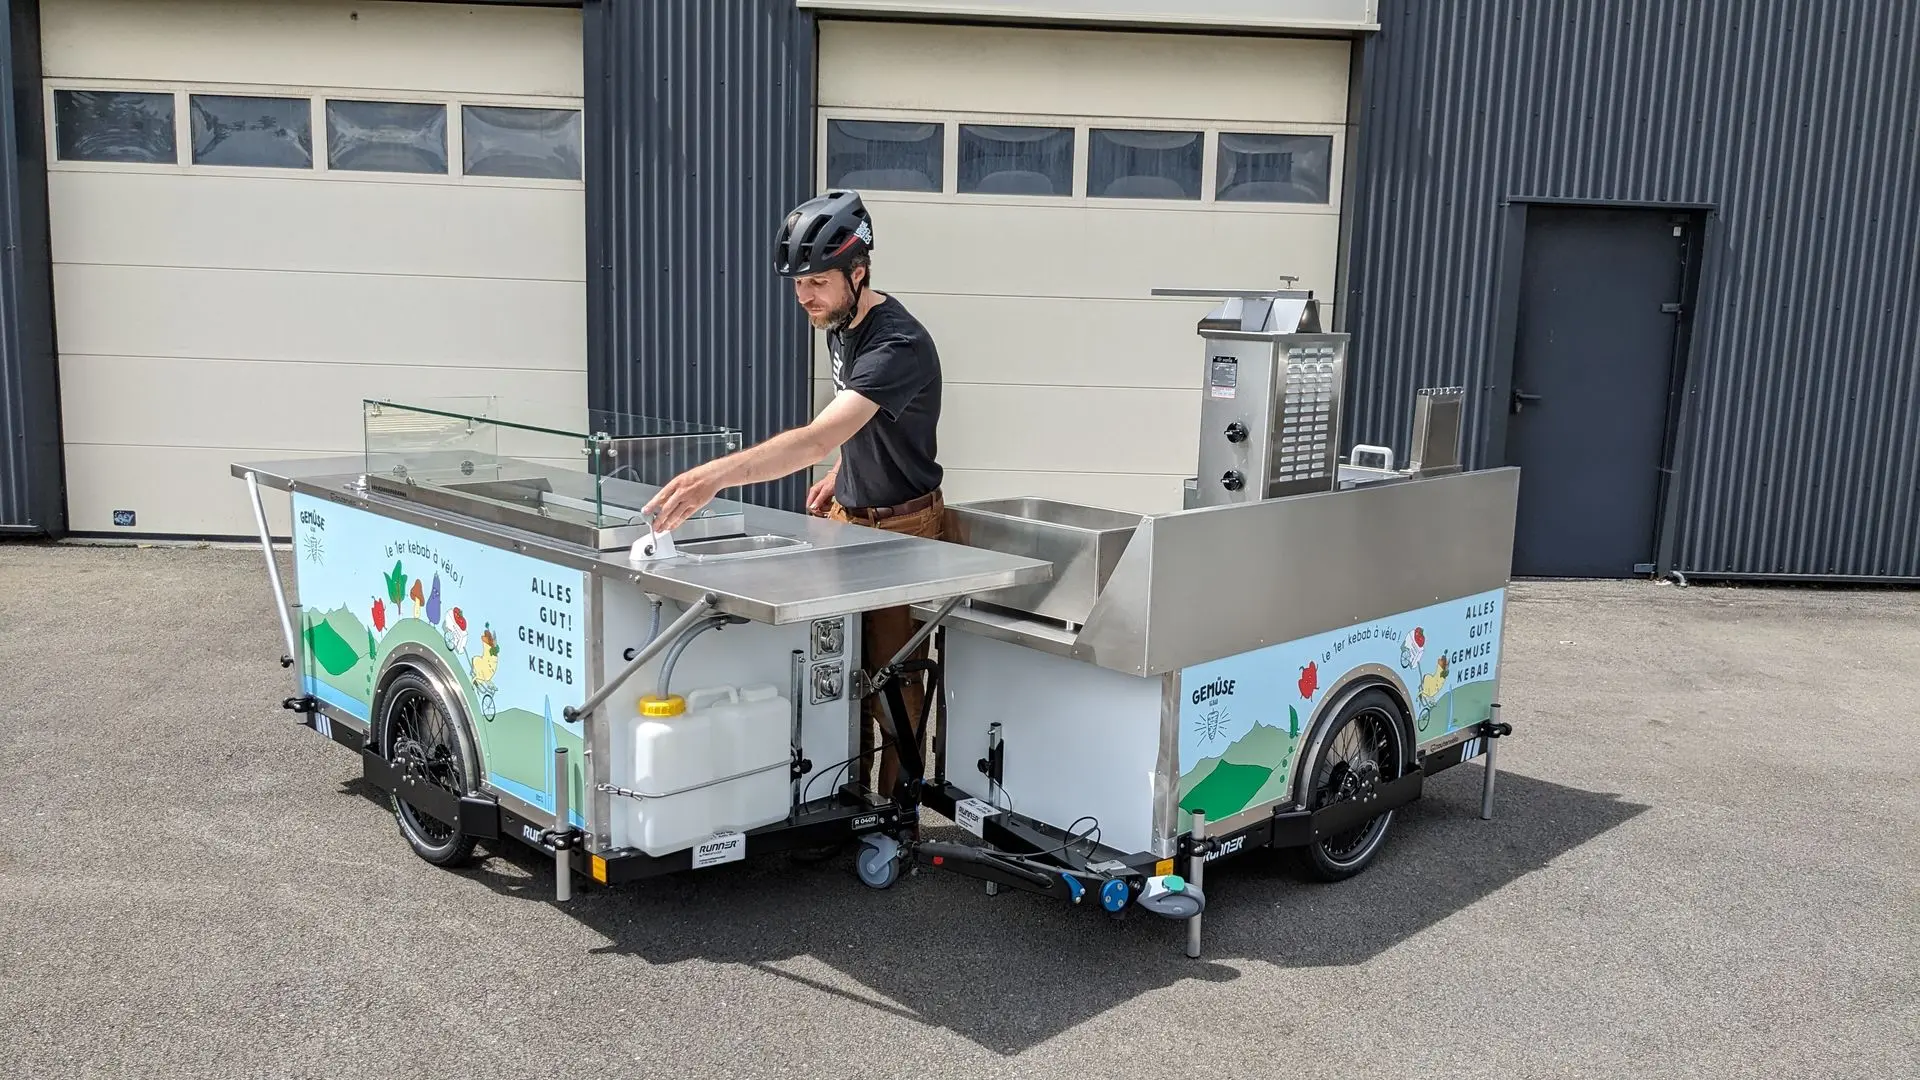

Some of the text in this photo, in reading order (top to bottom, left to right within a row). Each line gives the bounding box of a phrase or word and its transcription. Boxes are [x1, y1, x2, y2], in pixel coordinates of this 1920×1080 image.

[407, 539, 431, 559] kebab
[440, 558, 459, 582] vélo
[531, 577, 572, 604] ALLES
[540, 606, 572, 632] GUT!
[1465, 600, 1495, 620] ALLES
[518, 625, 573, 659] GEMUSE
[1347, 626, 1372, 646] kebab
[1381, 625, 1397, 641] vélo
[1469, 620, 1493, 639] GUT!
[1451, 641, 1491, 665] GEMUSE
[528, 654, 573, 685] KEBAB
[1456, 661, 1489, 684] KEBAB
[1191, 675, 1236, 705] GEMÜSE
[699, 840, 737, 854] RUNNER
